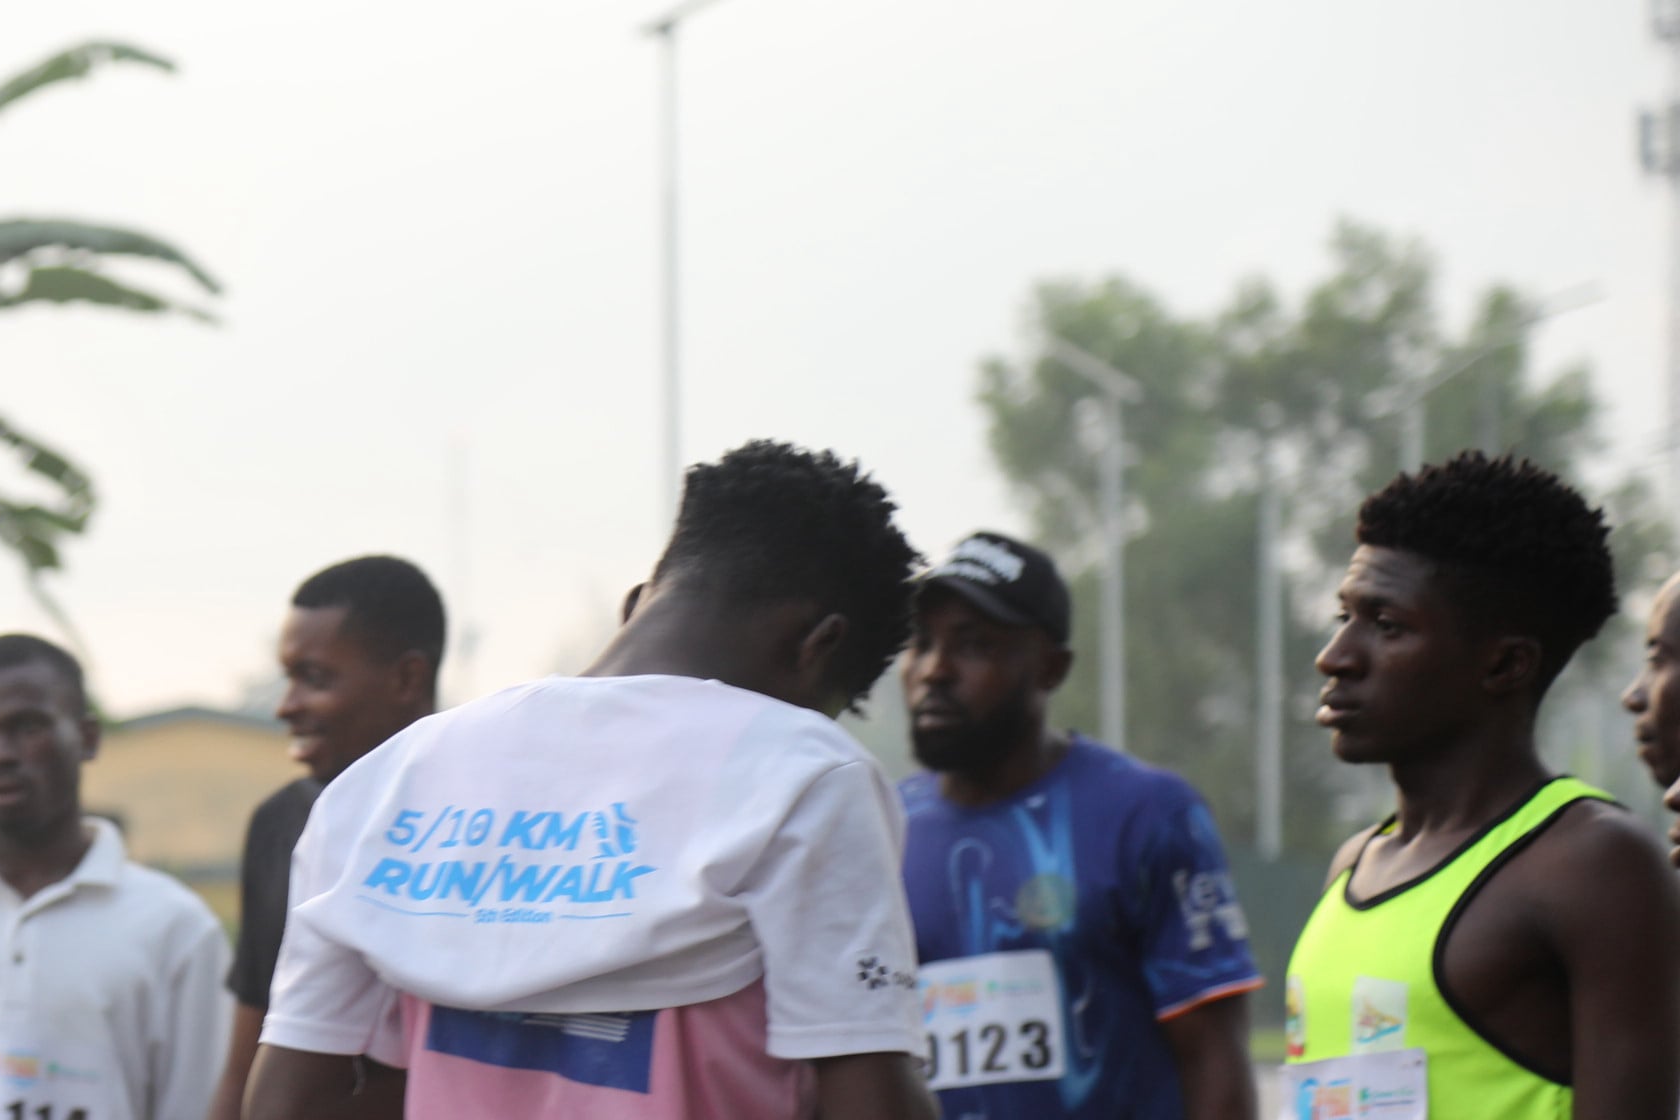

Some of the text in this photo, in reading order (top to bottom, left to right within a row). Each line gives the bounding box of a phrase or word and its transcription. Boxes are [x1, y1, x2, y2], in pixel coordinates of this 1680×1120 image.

[385, 805, 592, 853] 5/10 KM
[363, 854, 658, 907] RUN/WALK
